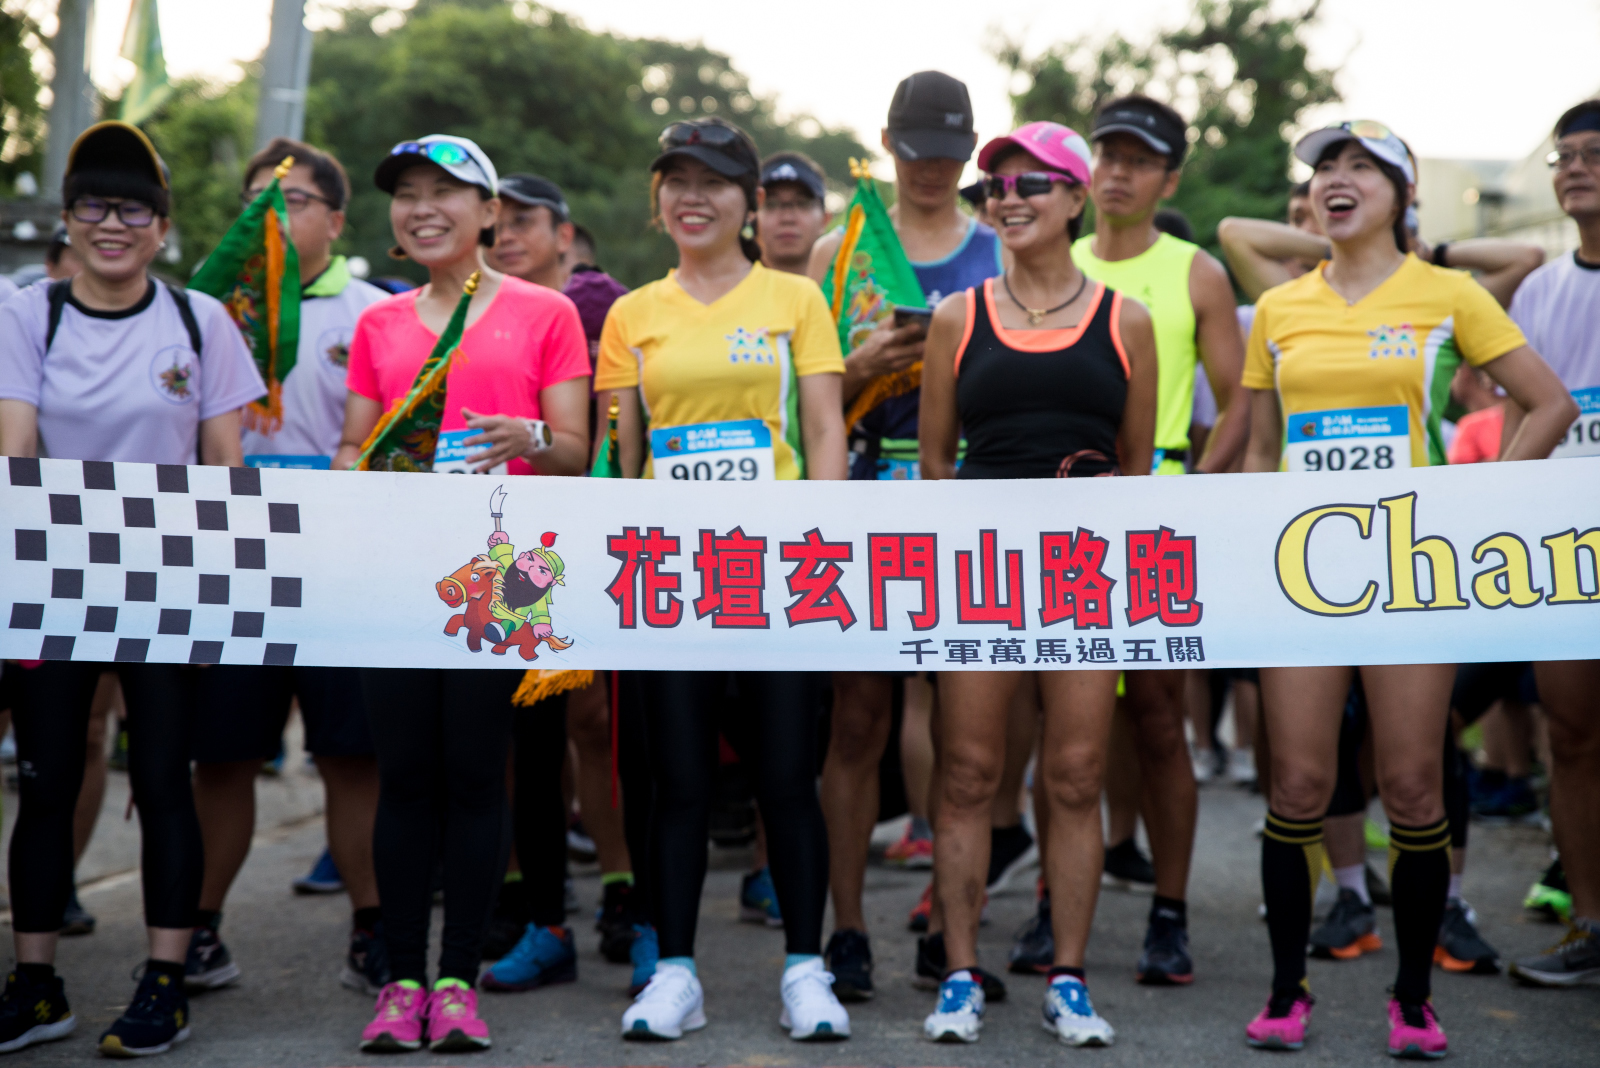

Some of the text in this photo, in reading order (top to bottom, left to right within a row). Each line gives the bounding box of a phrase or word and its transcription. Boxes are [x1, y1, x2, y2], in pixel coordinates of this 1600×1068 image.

[670, 457, 758, 480] 9029
[1304, 445, 1394, 471] 9028
[604, 525, 1203, 632] 花壇玄門山路跑
[899, 636, 1206, 665] 千軍萬馬過五關
